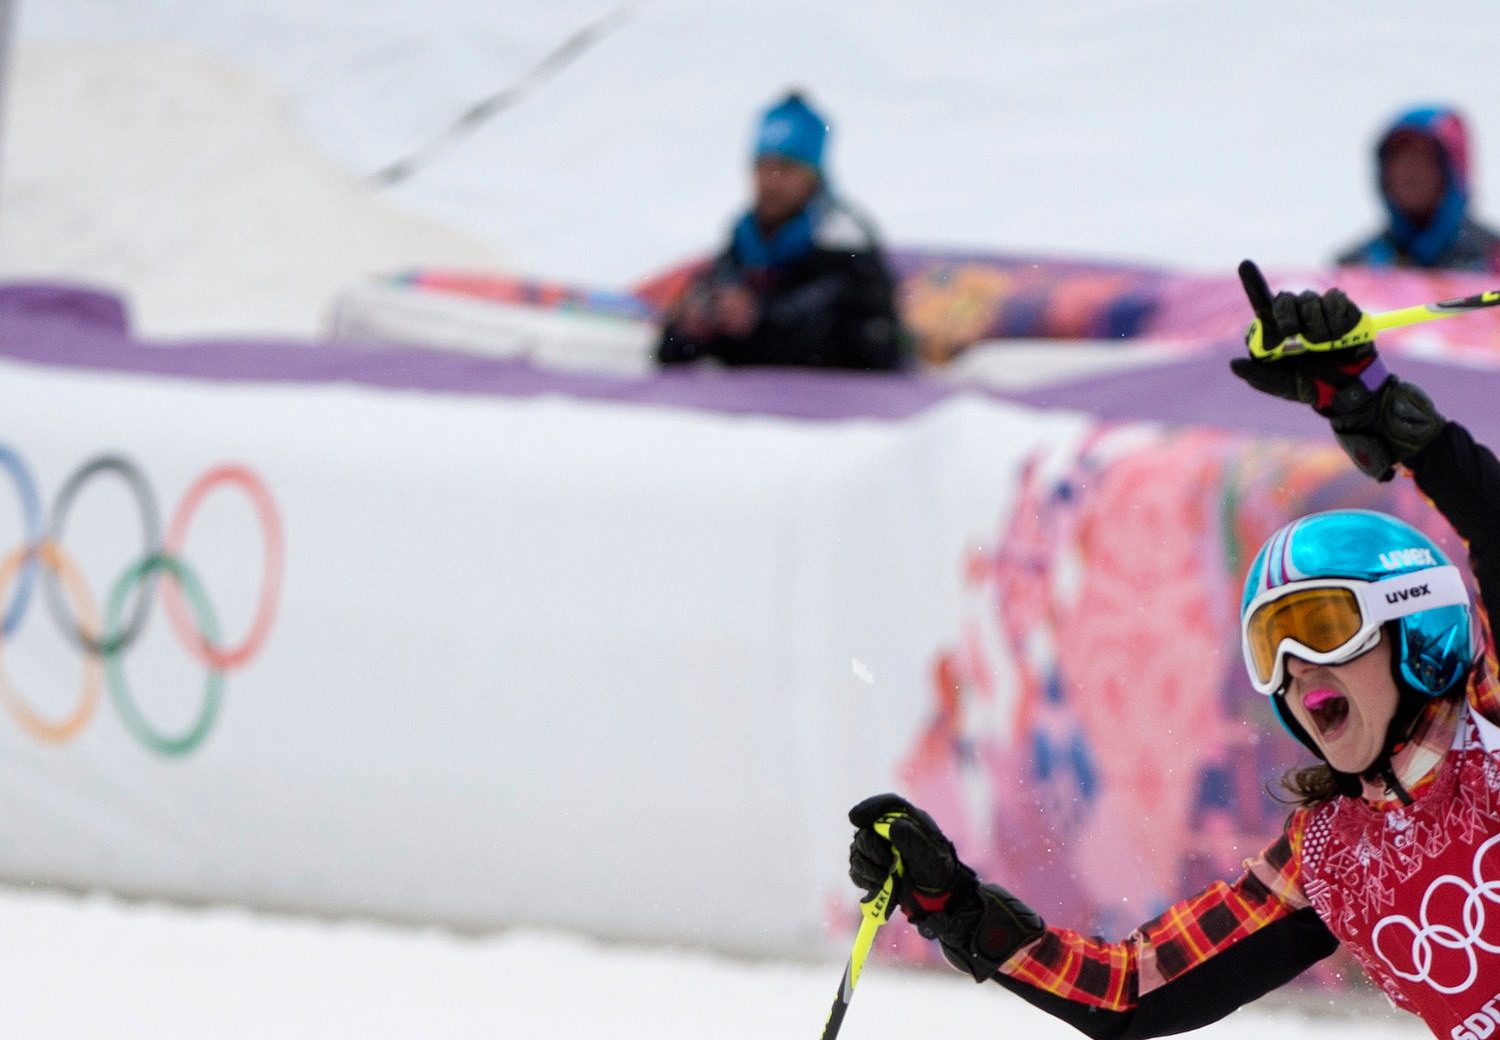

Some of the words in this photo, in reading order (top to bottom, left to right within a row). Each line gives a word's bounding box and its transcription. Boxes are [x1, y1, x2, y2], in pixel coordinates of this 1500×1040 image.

[1378, 547, 1438, 571] uvex
[1385, 582, 1432, 605] uvex
[871, 888, 890, 918] LEKI
